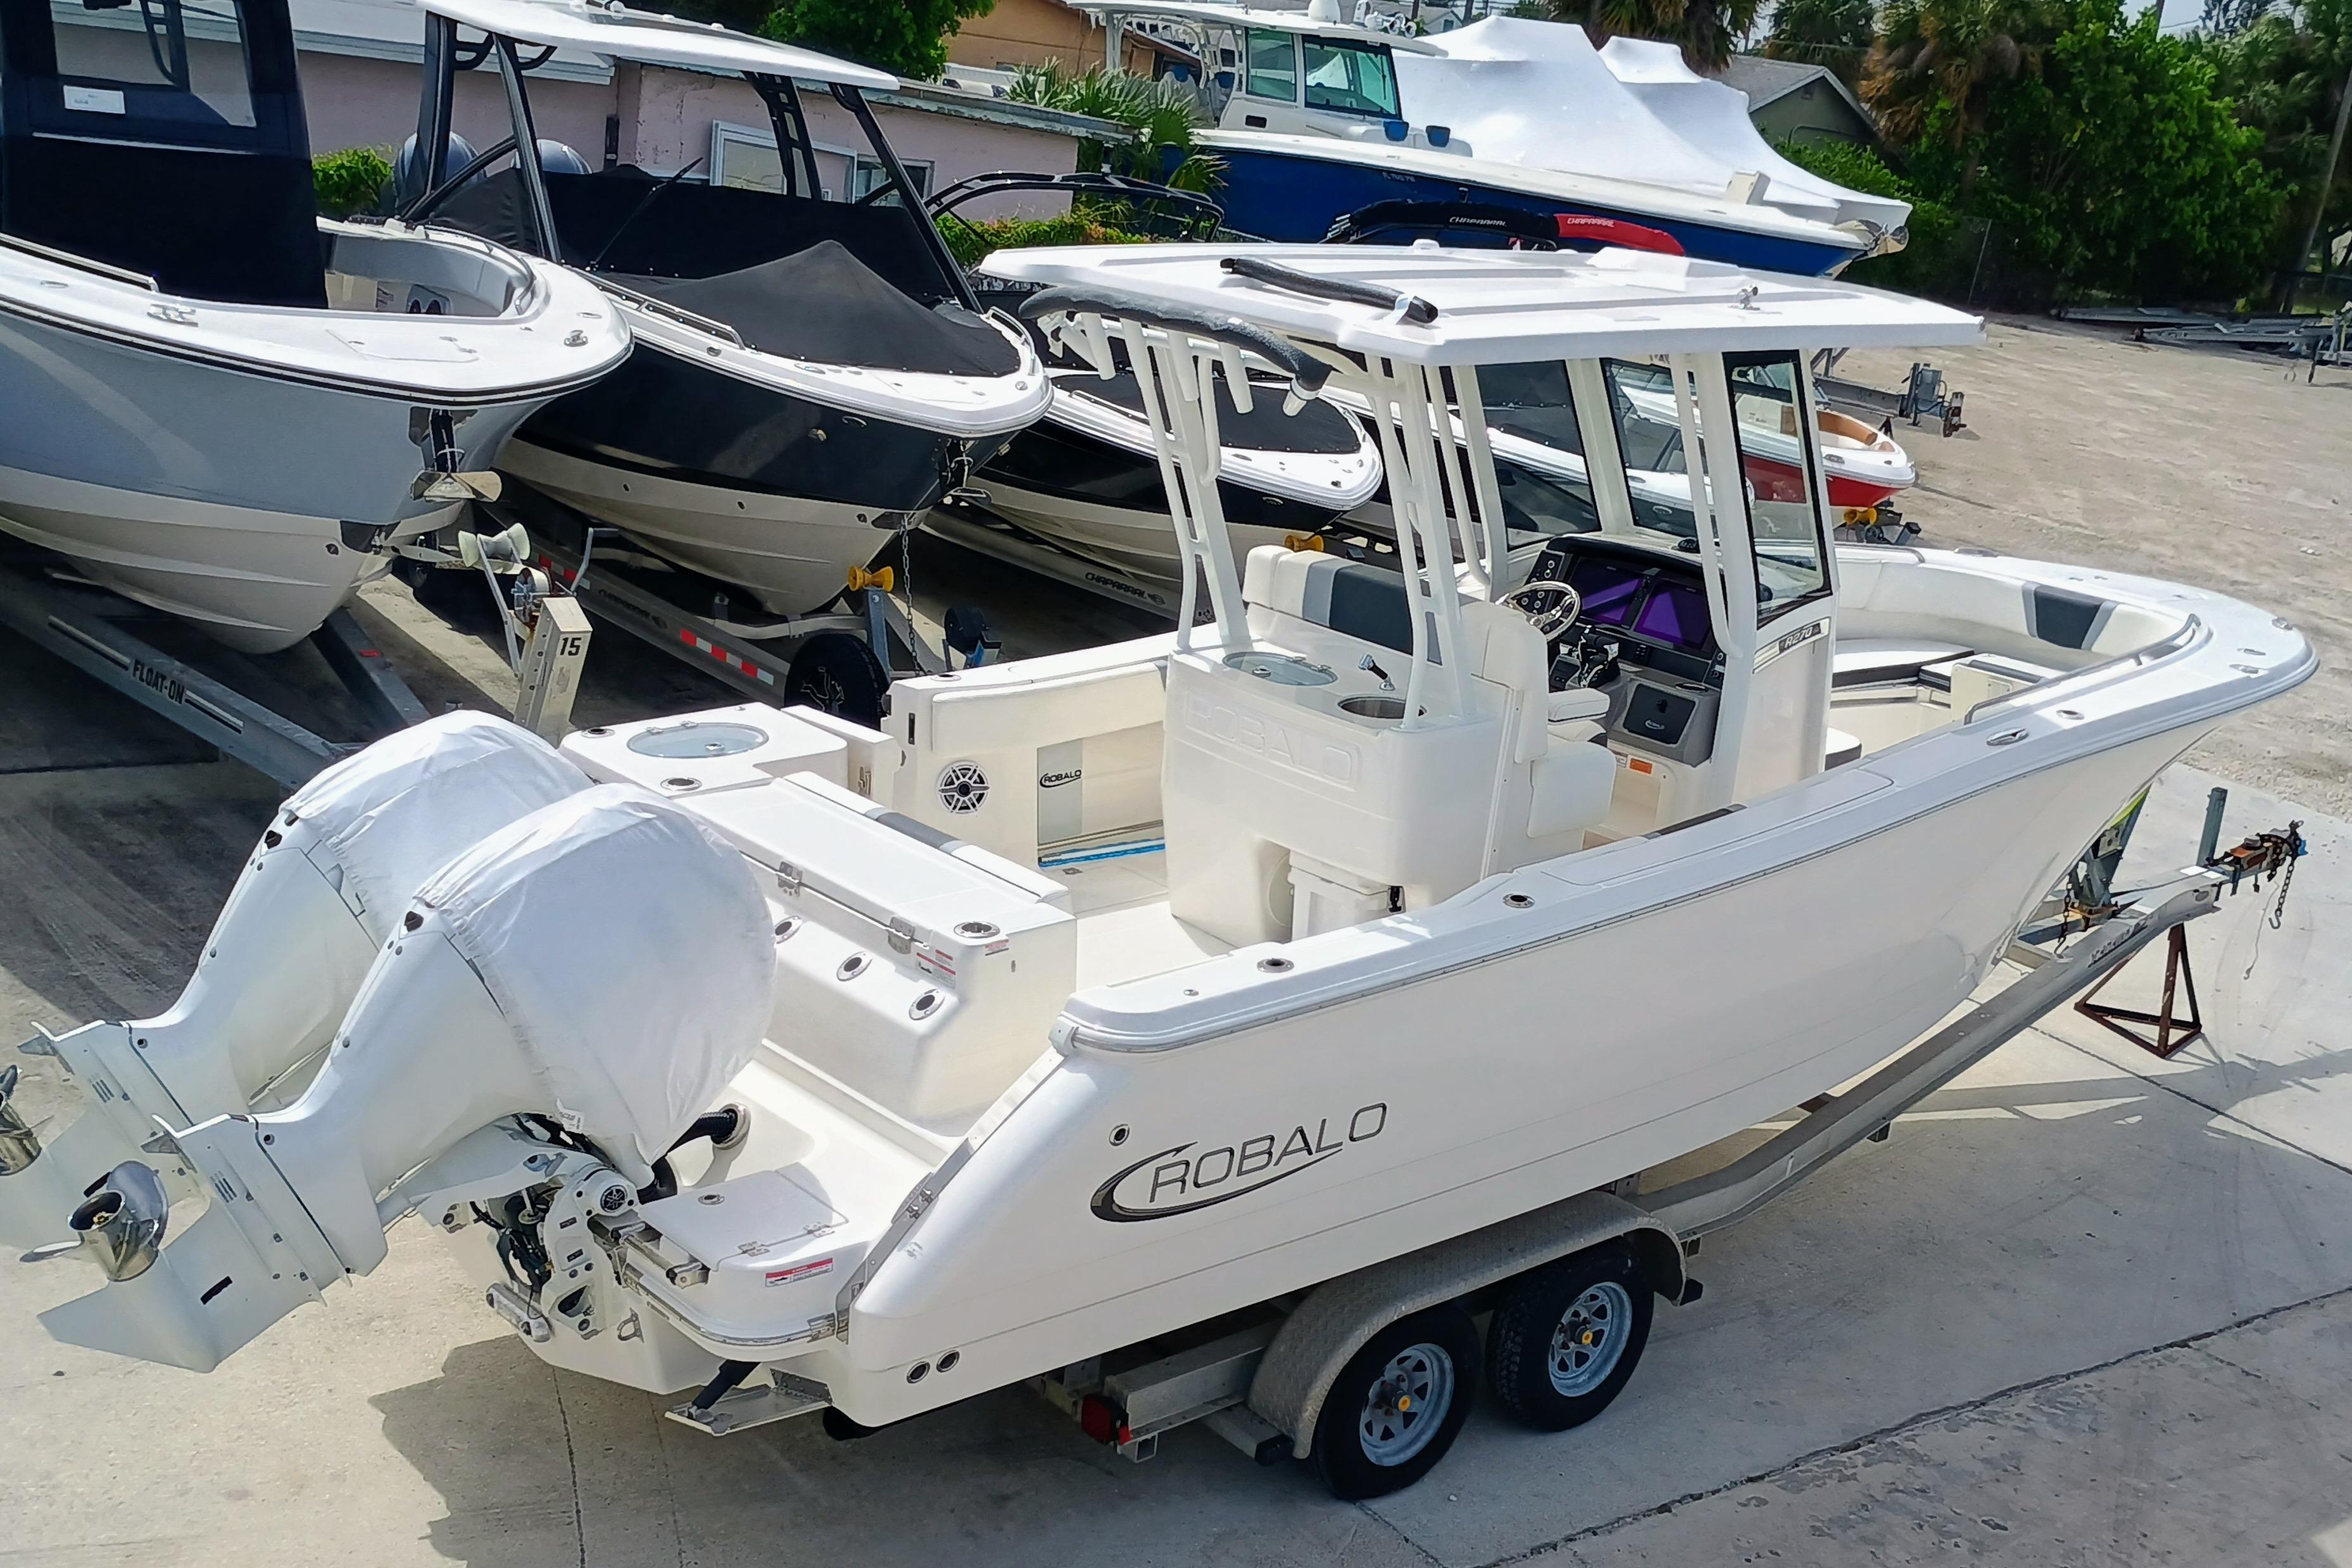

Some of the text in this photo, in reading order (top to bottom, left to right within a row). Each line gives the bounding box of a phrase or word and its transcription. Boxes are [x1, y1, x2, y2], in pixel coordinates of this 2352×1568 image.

[1085, 572, 1147, 600] CHAPARRAL
[560, 637, 582, 656] 15
[132, 658, 185, 705] FLOAT-ON
[1043, 769, 1082, 784] ROBALO
[1148, 1102, 1387, 1203] ROBALO
